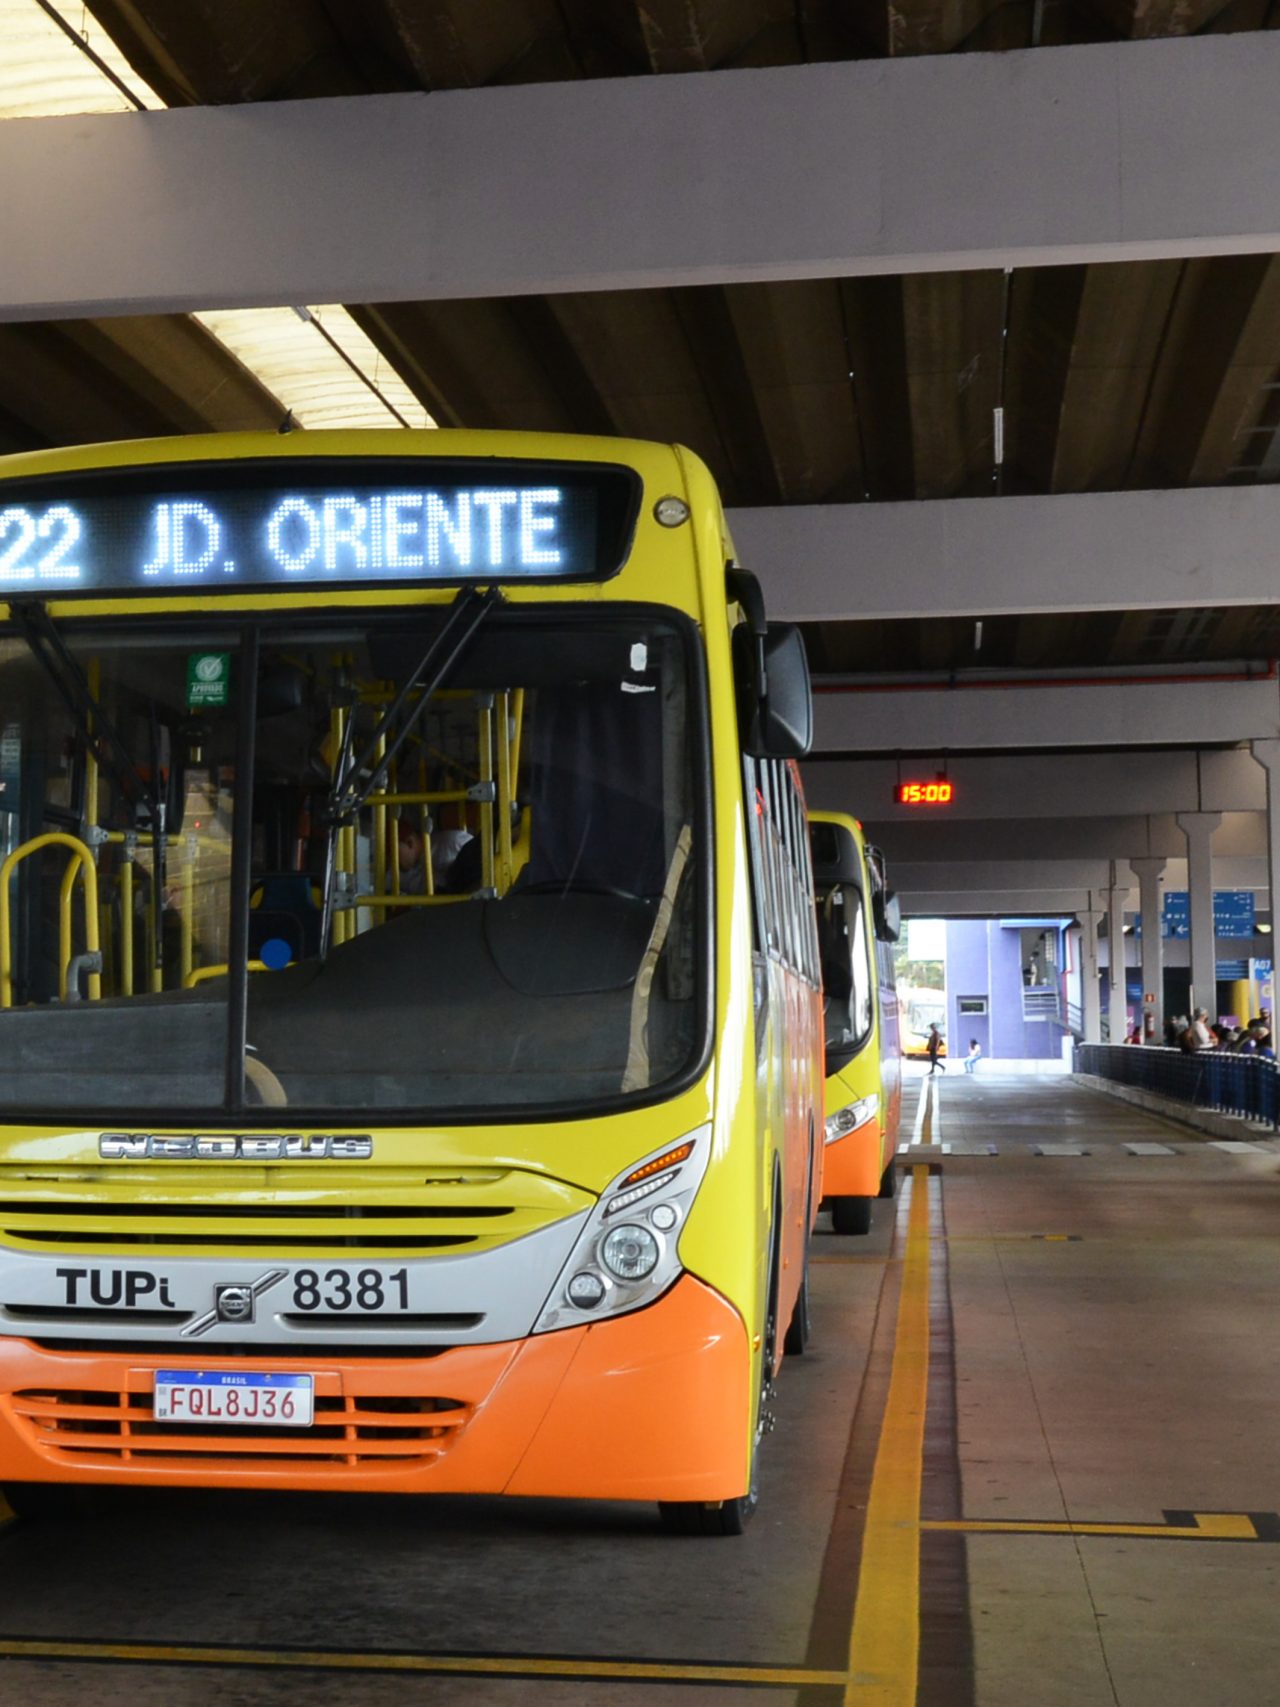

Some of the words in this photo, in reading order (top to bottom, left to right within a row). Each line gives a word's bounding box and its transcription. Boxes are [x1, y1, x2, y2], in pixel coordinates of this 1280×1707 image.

[143, 502, 236, 576] JD.
[267, 489, 562, 572] ORIENTE
[902, 785, 951, 802] 15:00
[99, 1133, 372, 1159] NEOBUS
[292, 1268, 409, 1310] 8381
[221, 1376, 247, 1385] BRASIL
[171, 1388, 295, 1419] FQL8J36
